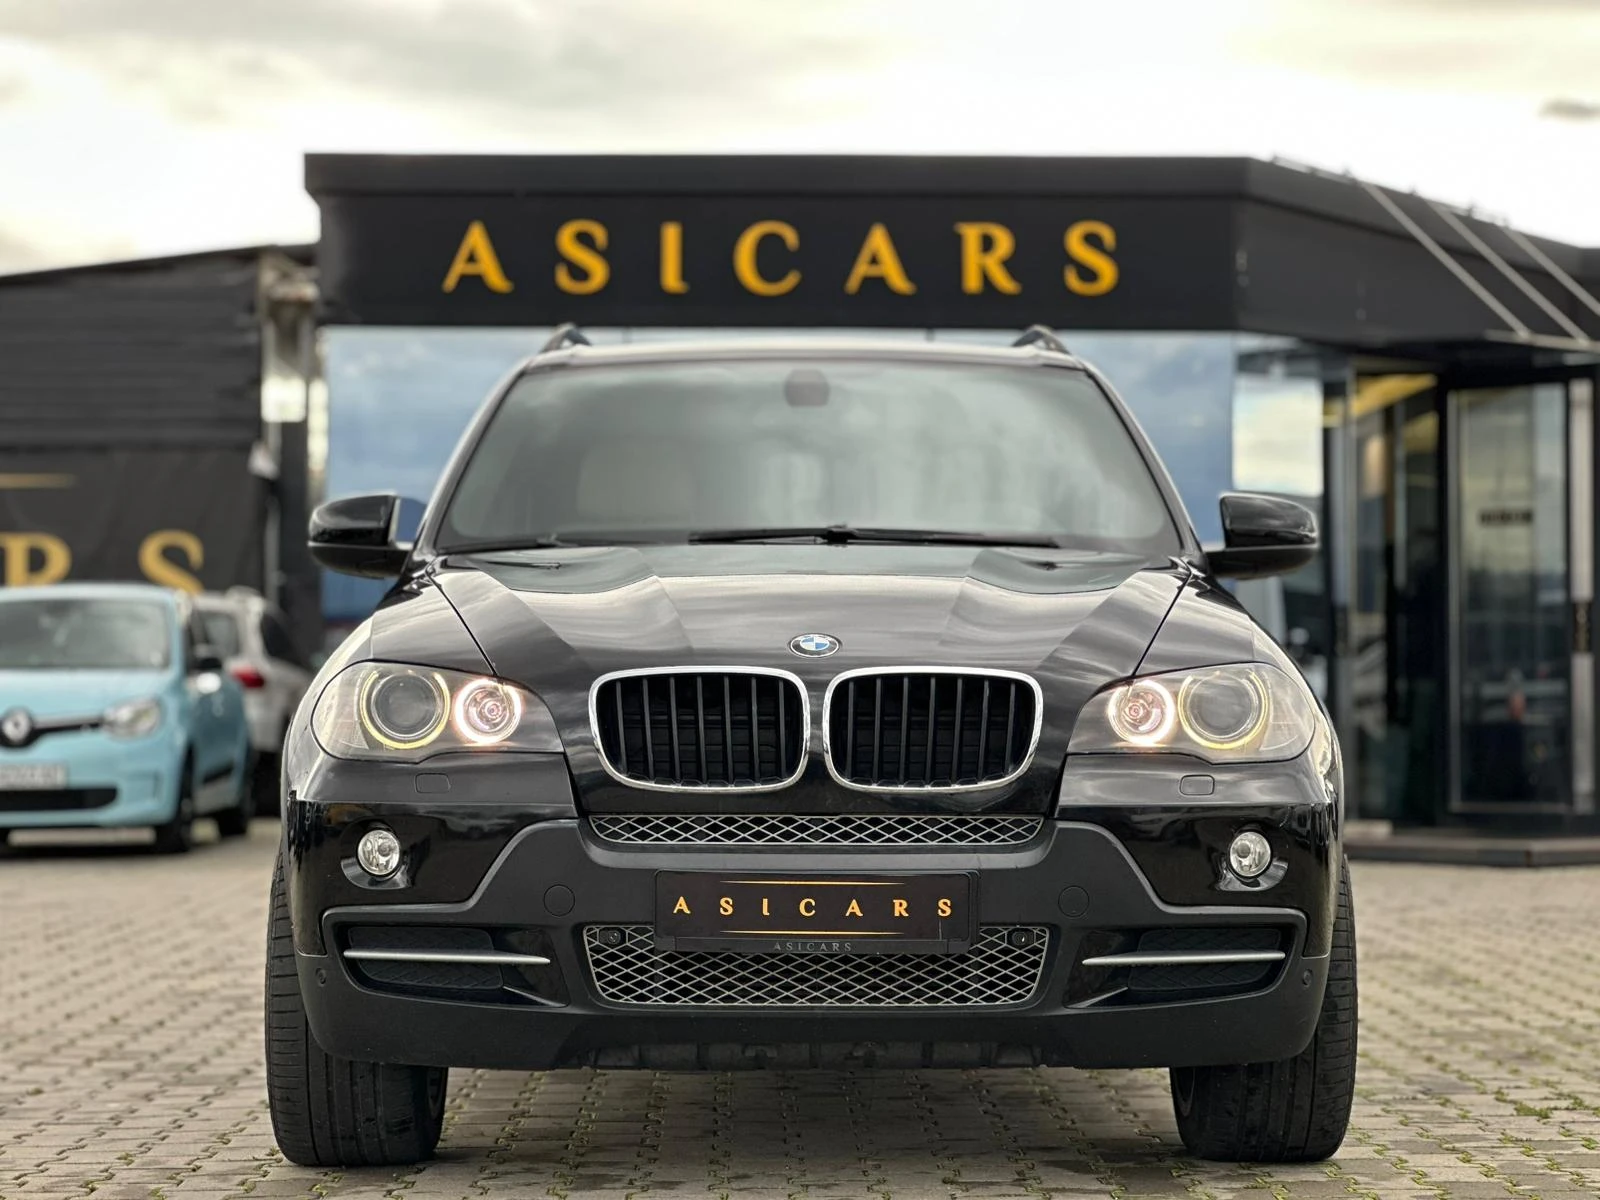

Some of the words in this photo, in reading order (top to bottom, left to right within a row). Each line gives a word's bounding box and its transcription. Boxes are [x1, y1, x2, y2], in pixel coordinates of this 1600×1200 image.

[442, 219, 1119, 296] ASICARS
[673, 896, 953, 917] ASICARS
[773, 942, 852, 952] ASICARS
